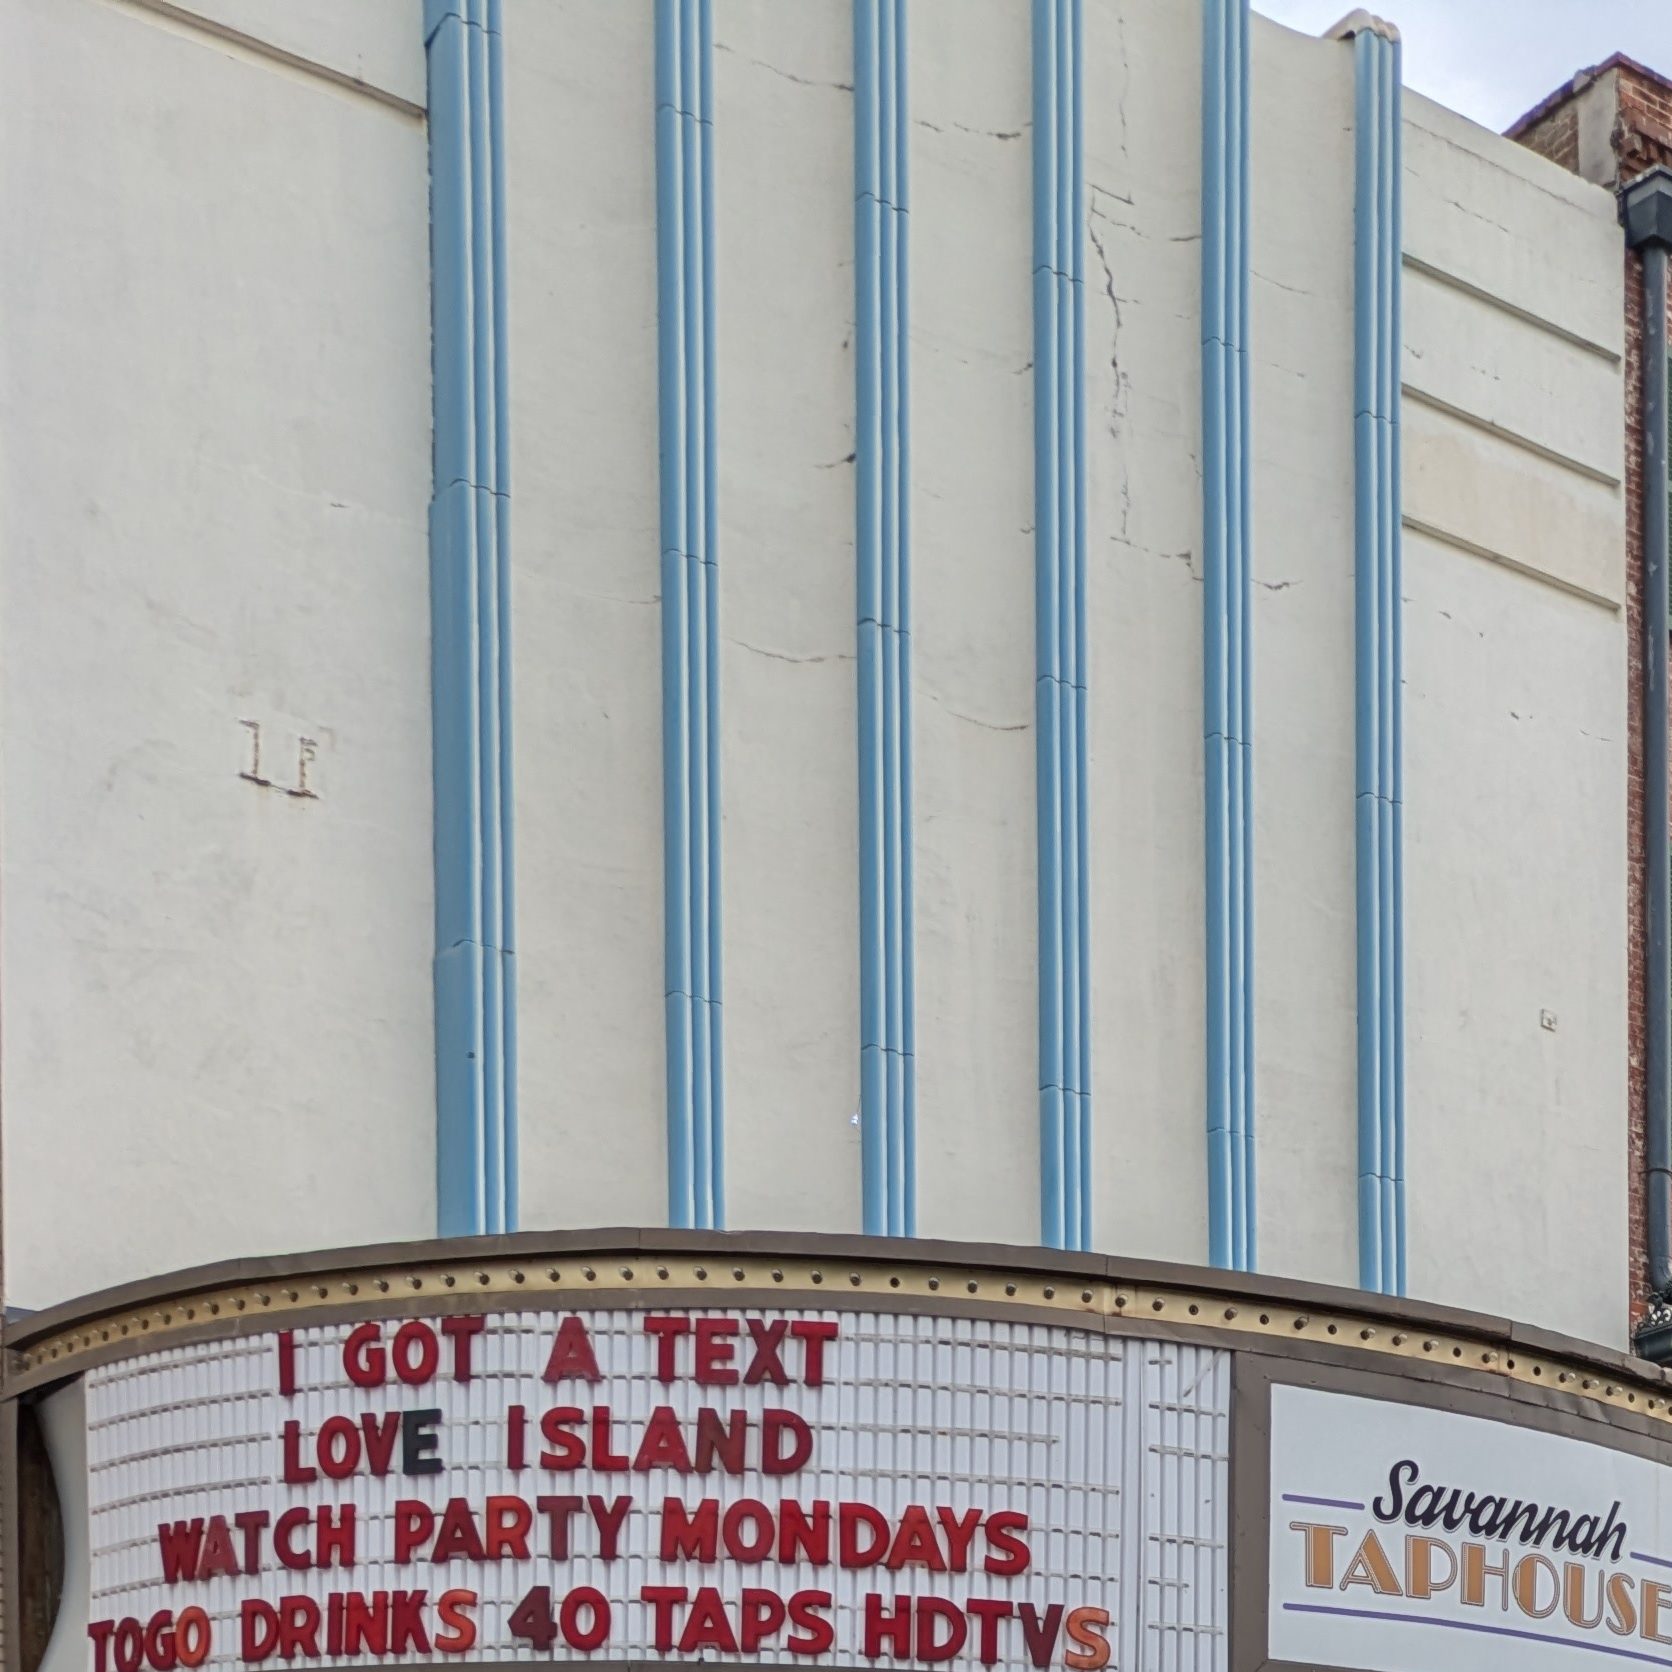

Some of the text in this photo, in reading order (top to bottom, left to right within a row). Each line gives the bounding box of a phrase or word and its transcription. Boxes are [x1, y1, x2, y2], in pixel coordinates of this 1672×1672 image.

[278, 1316, 838, 1396] I GOT A TEXT
[283, 1405, 813, 1484] LOVE ISLAND
[157, 1494, 1032, 1585] WATCH PARTY MONDAYS
[1372, 1459, 1629, 1562] Savannah
[241, 1588, 478, 1664] DRINKS
[507, 1585, 611, 1652] 40
[640, 1586, 835, 1655] TAPS
[863, 1593, 1111, 1672] HDTVS
